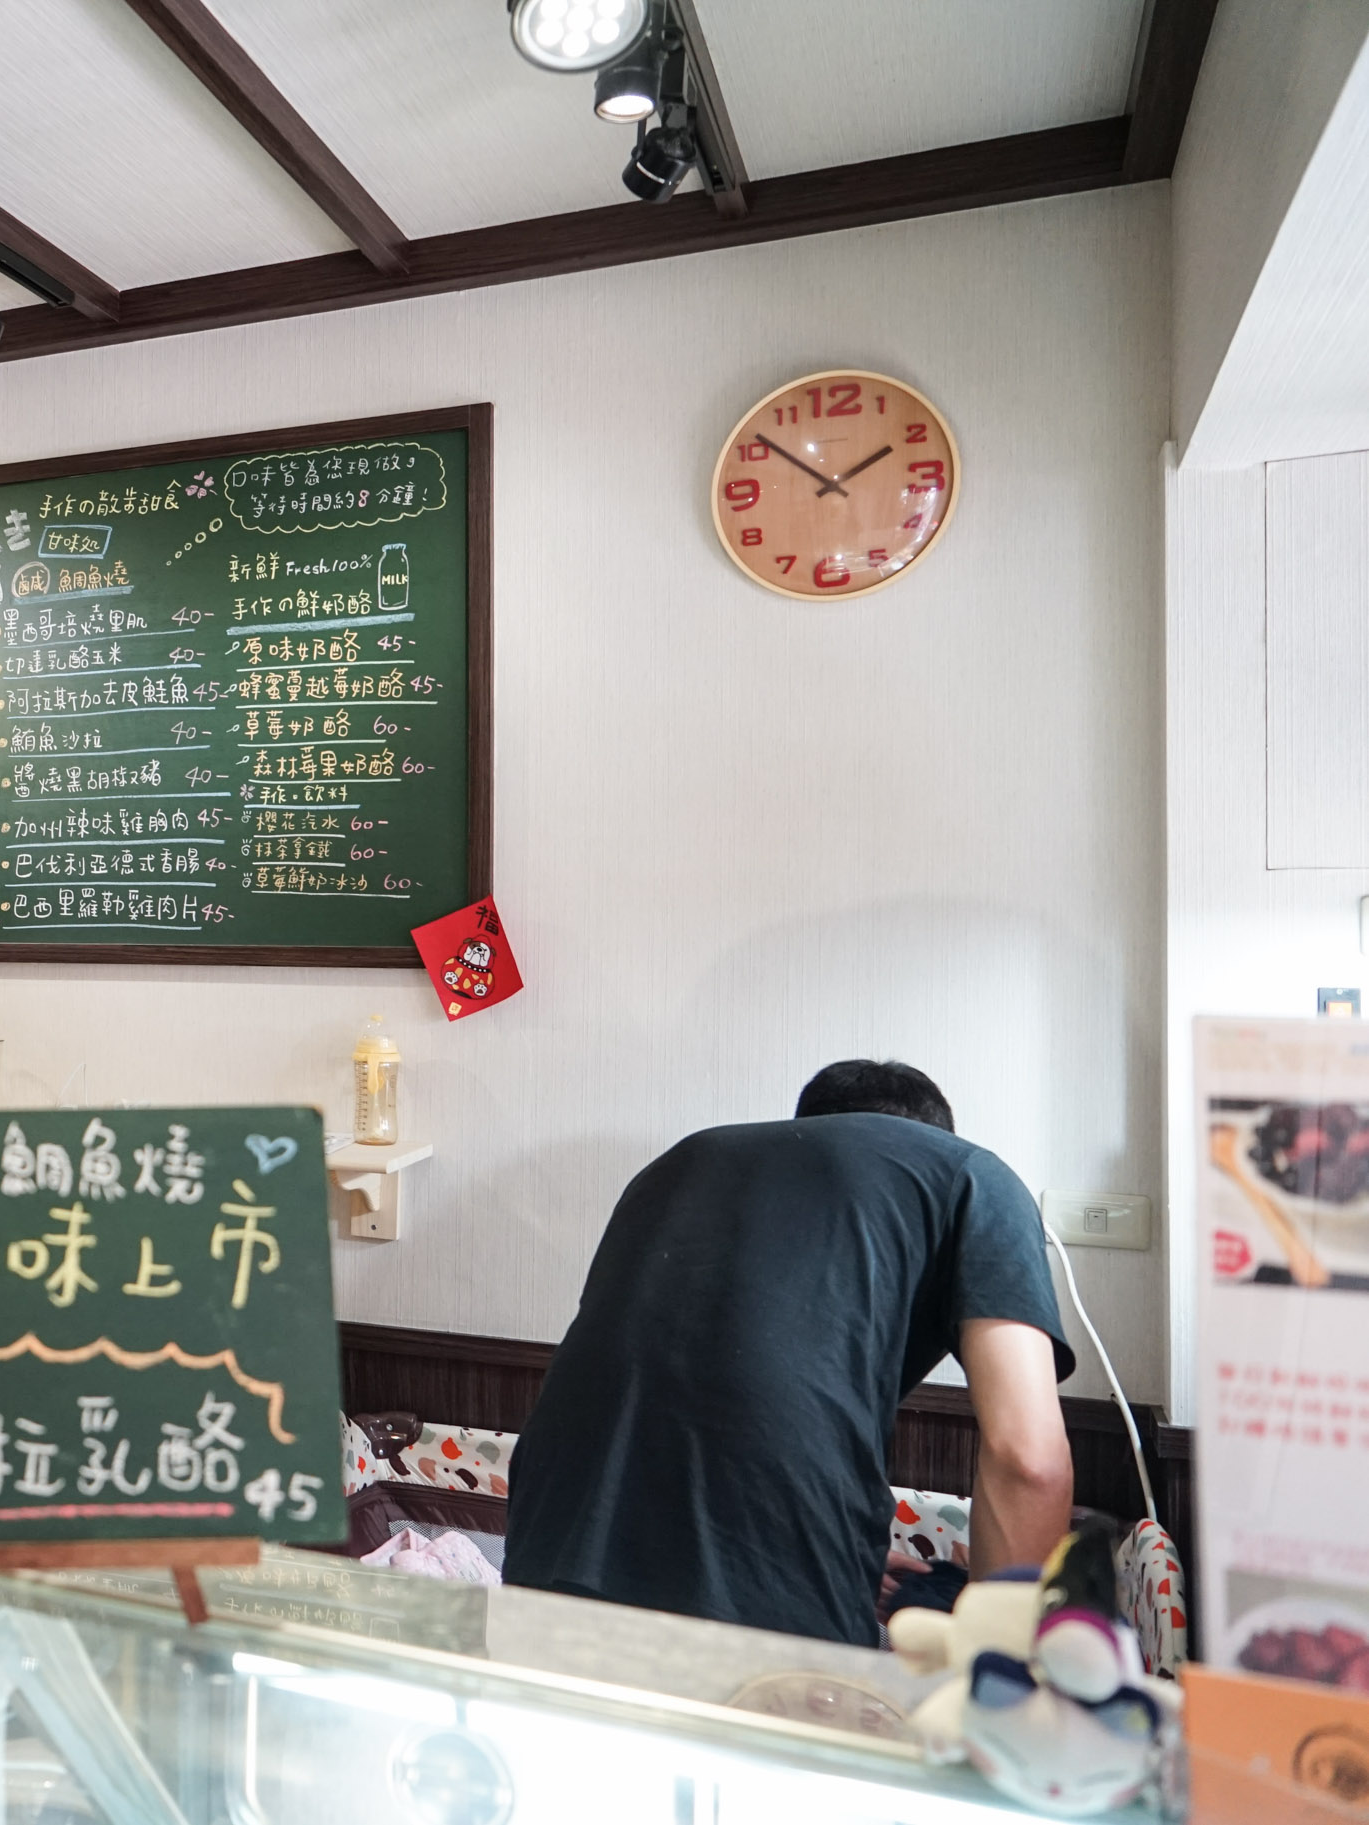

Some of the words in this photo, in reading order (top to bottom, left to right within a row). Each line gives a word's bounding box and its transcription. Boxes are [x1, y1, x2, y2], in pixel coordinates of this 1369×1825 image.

[774, 405, 798, 426] 11
[807, 383, 862, 419] 12
[876, 395, 886, 415] 1
[905, 423, 927, 444] 2
[737, 442, 770, 462] 10
[908, 460, 945, 494] 3
[725, 478, 760, 512] 9
[741, 528, 763, 547] 8
[229, 551, 280, 583] 新鮮
[775, 555, 797, 575] 7
[813, 556, 851, 588] 6
[868, 549, 889, 568] 5
[382, 574, 408, 585] MILK
[232, 589, 372, 620] 手作の鮮奶酪
[243, 628, 361, 664] 原味奶酪
[7, 673, 189, 715] 阿拉斯加去皮鮭魚
[10, 722, 103, 753] 鮪魚沙拉
[244, 708, 351, 740] 草莓奶酪
[475, 905, 499, 936] 福
[245, 1469, 324, 1522] 45
